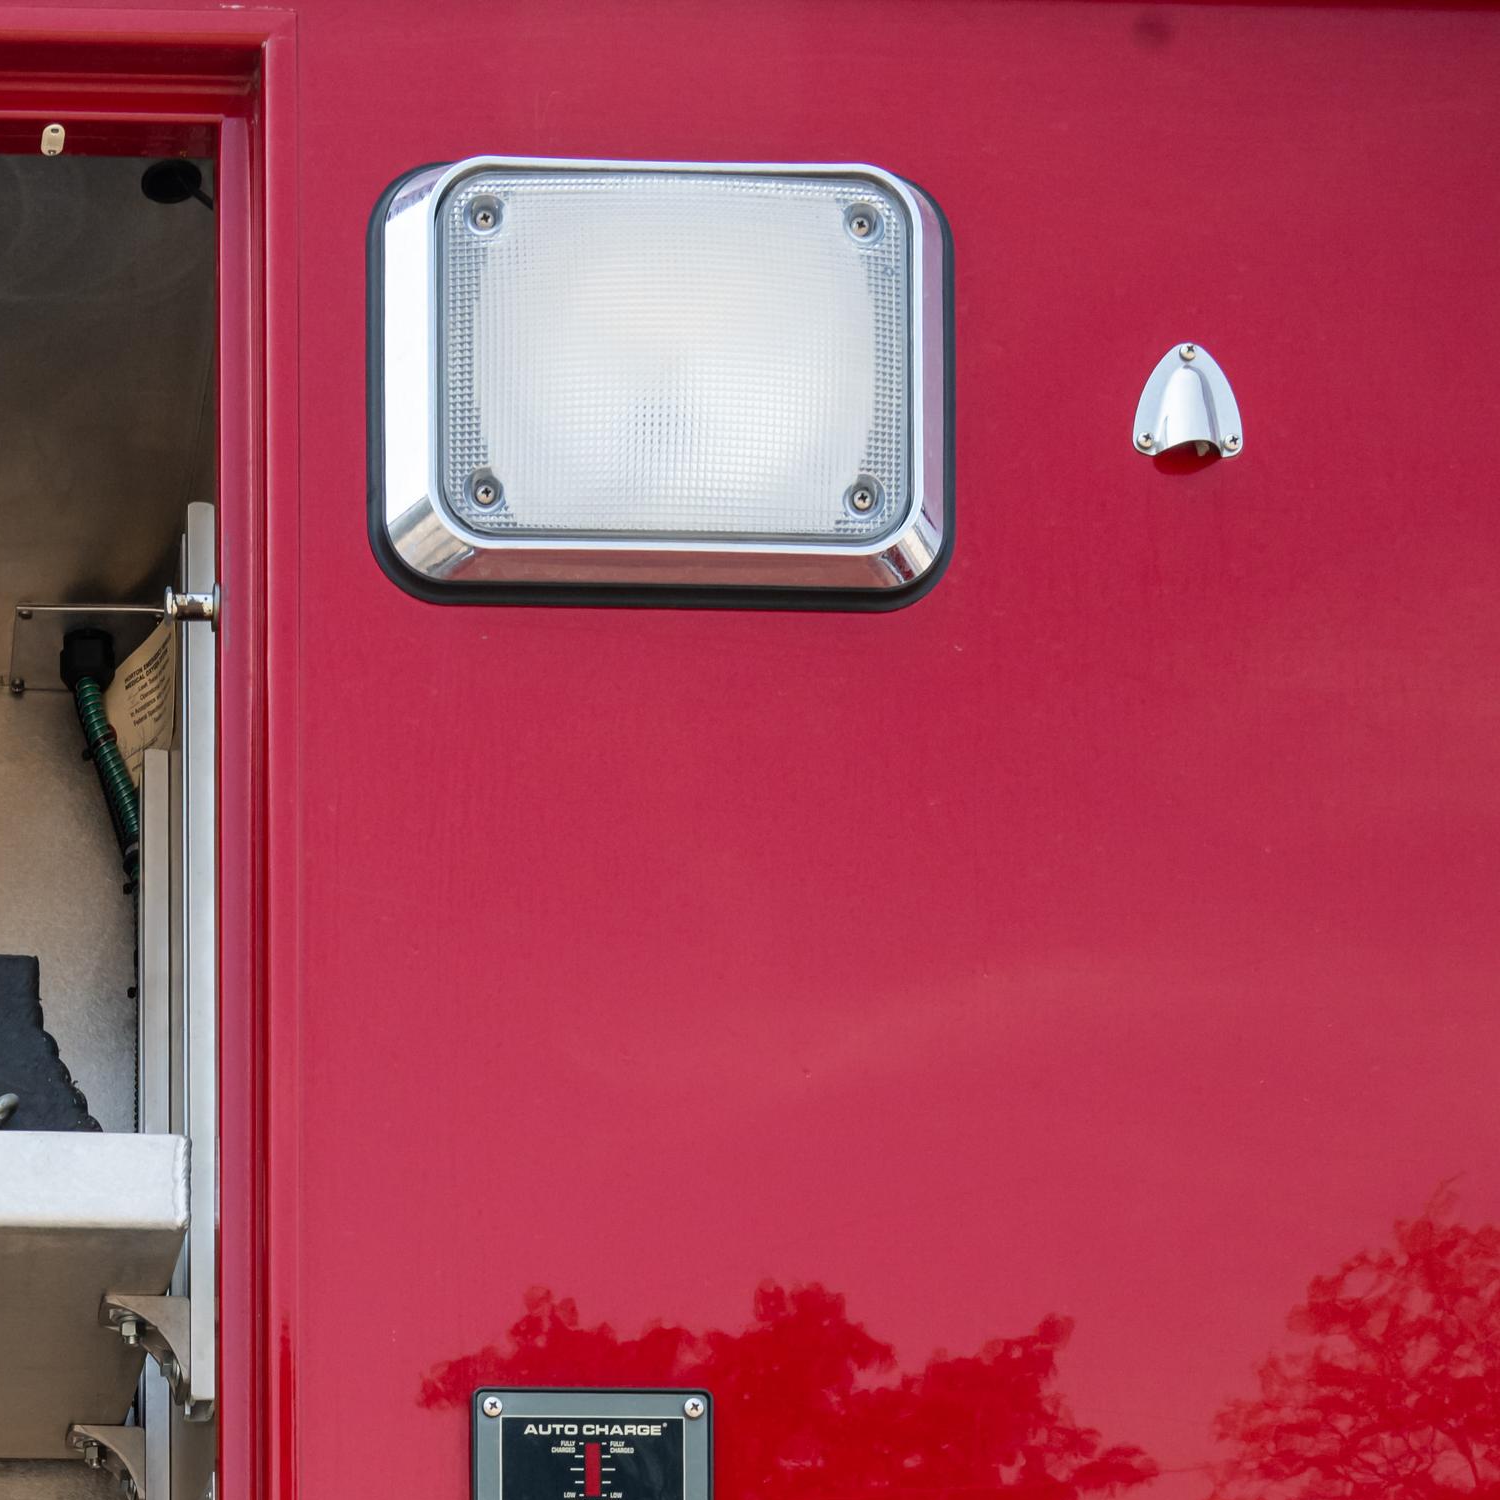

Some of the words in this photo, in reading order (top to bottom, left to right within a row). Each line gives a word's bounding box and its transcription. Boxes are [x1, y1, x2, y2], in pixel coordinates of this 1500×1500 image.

[524, 1424, 578, 1436] AUTO
[582, 1424, 662, 1436] CHARGE
[551, 1446, 576, 1454] CHARGED
